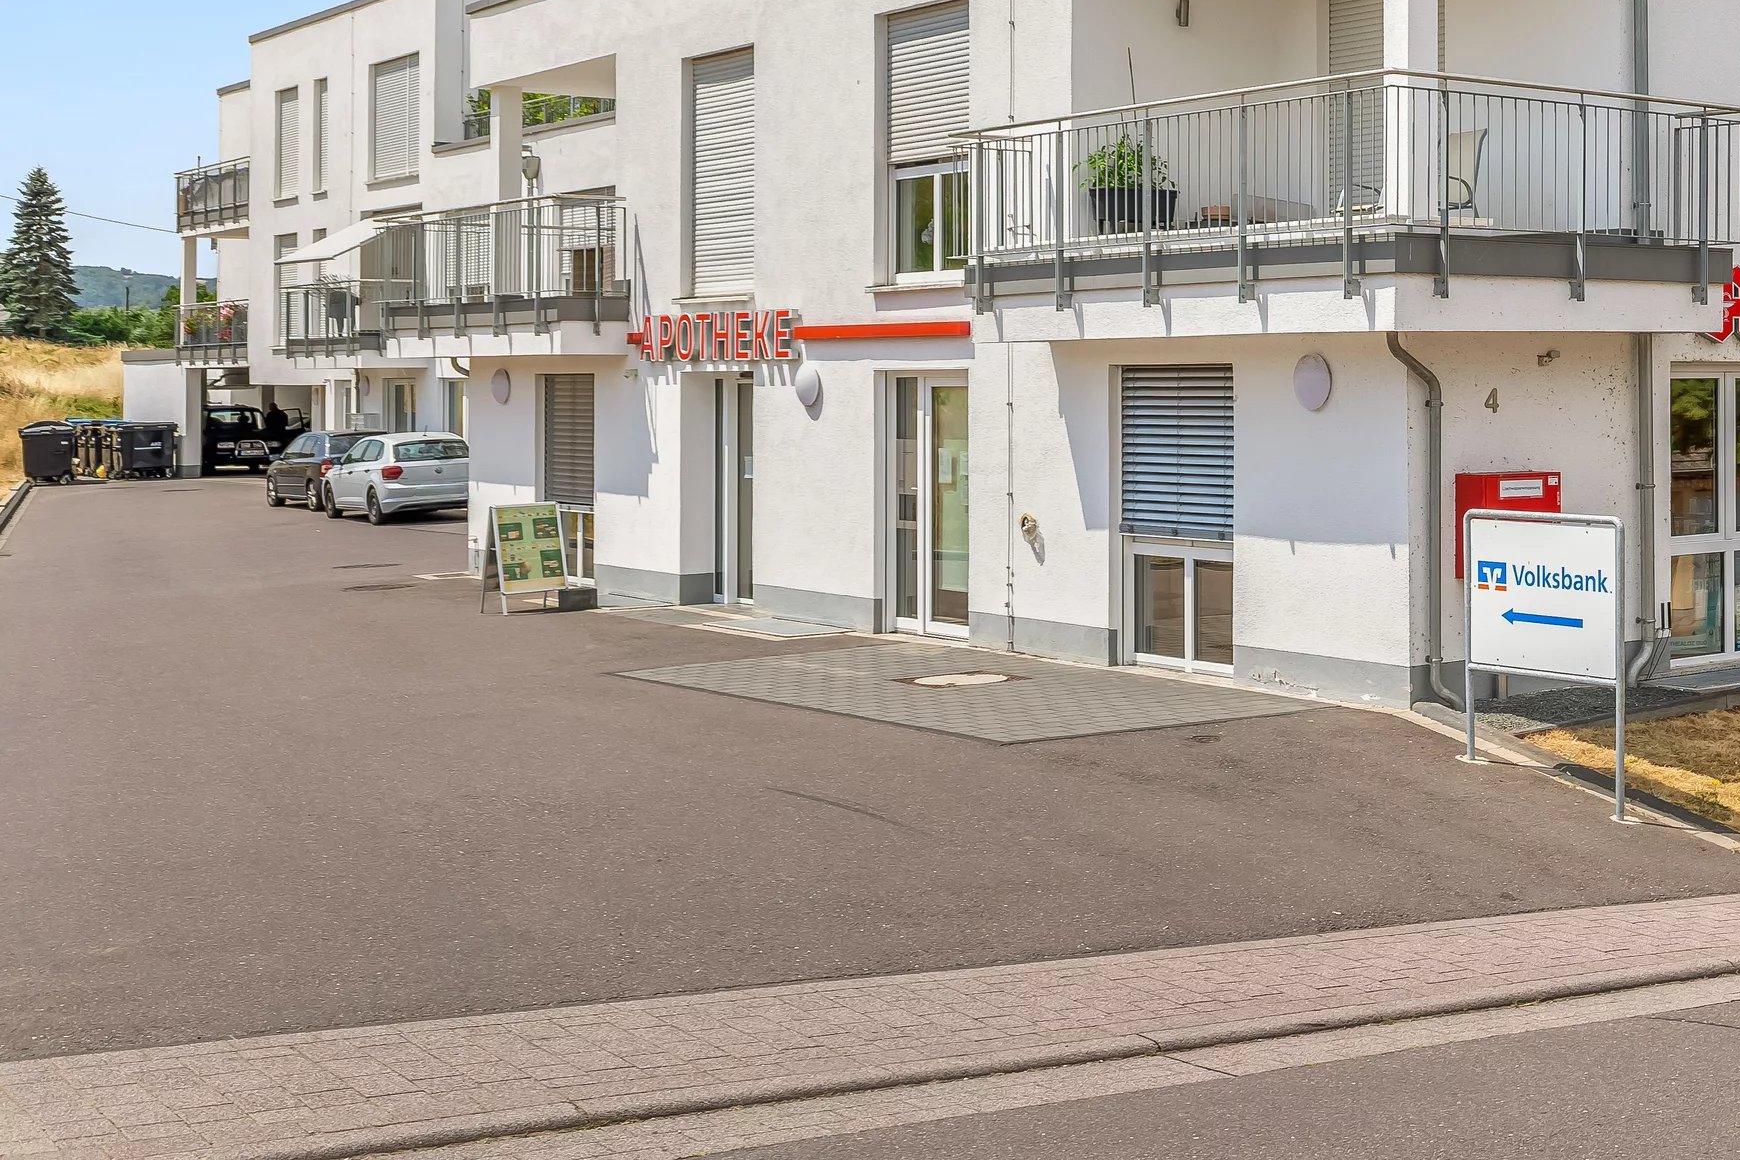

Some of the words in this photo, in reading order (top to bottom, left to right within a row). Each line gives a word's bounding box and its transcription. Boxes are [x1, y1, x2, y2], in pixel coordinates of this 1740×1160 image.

[639, 308, 793, 362] APOTHEKE
[1484, 387, 1500, 414] 4
[1512, 564, 1609, 593] Volksbank
